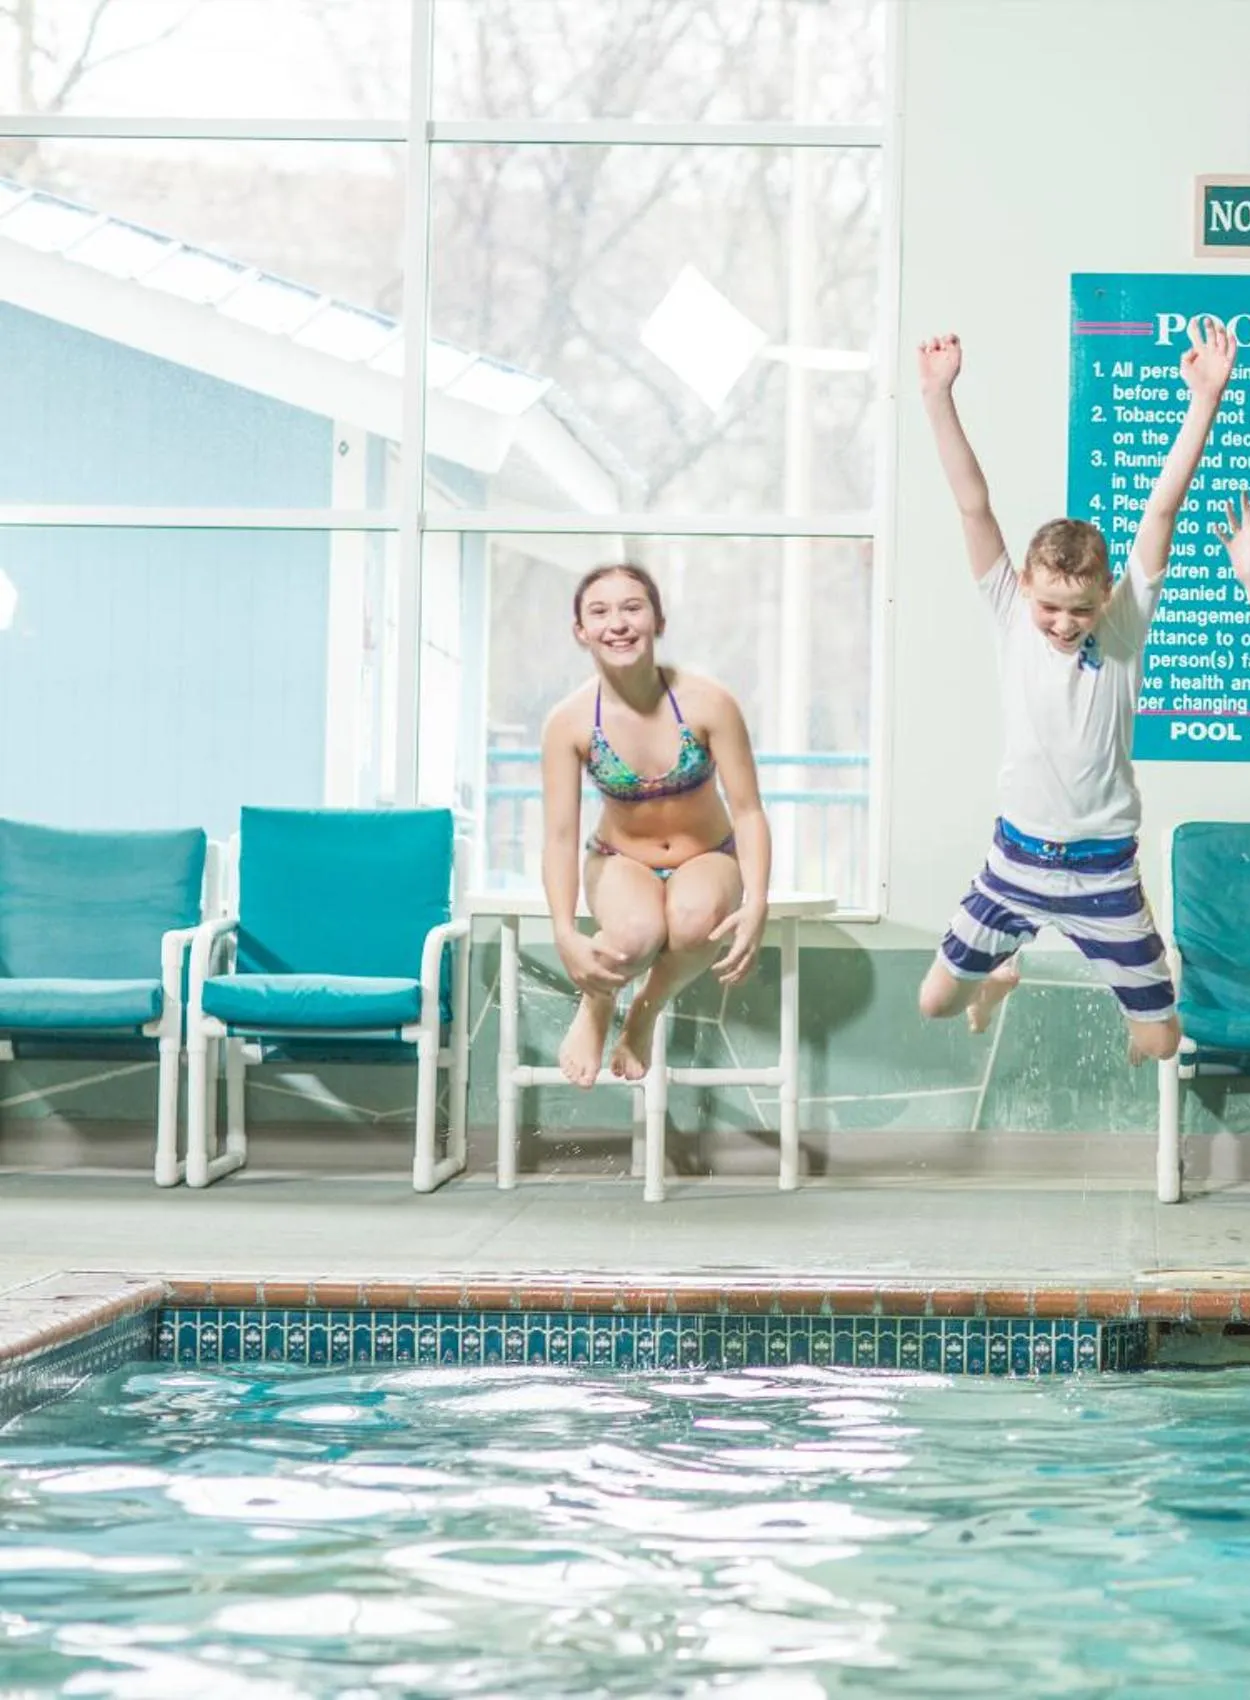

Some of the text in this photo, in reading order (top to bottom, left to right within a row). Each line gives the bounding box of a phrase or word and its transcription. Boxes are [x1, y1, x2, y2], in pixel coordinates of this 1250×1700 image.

[1092, 362, 1105, 378] 1.
[1111, 361, 1133, 378] All
[1140, 365, 1181, 382] pers
[1113, 384, 1169, 401] before
[1091, 406, 1107, 422] 2.
[1114, 406, 1186, 423] Tobacco
[1216, 408, 1245, 424] not
[1113, 431, 1135, 445] on
[1142, 429, 1169, 445] the
[1091, 450, 1107, 467] 3.
[1114, 451, 1166, 467] Runni
[1200, 452, 1222, 468] nd
[1111, 473, 1127, 489] in
[1089, 494, 1106, 511] 4.
[1113, 494, 1149, 511] Plea
[1091, 516, 1106, 532] 5.
[1177, 518, 1199, 534] do
[1203, 543, 1223, 557] or
[1166, 561, 1209, 579] ldren
[1216, 565, 1237, 580] an
[1160, 584, 1227, 604] mpanied
[1147, 628, 1208, 646] ittance
[1216, 630, 1234, 646] to
[1150, 650, 1234, 670] person(s)
[1170, 674, 1224, 690] health
[1172, 693, 1248, 715] changing
[1170, 722, 1242, 741] POOL
